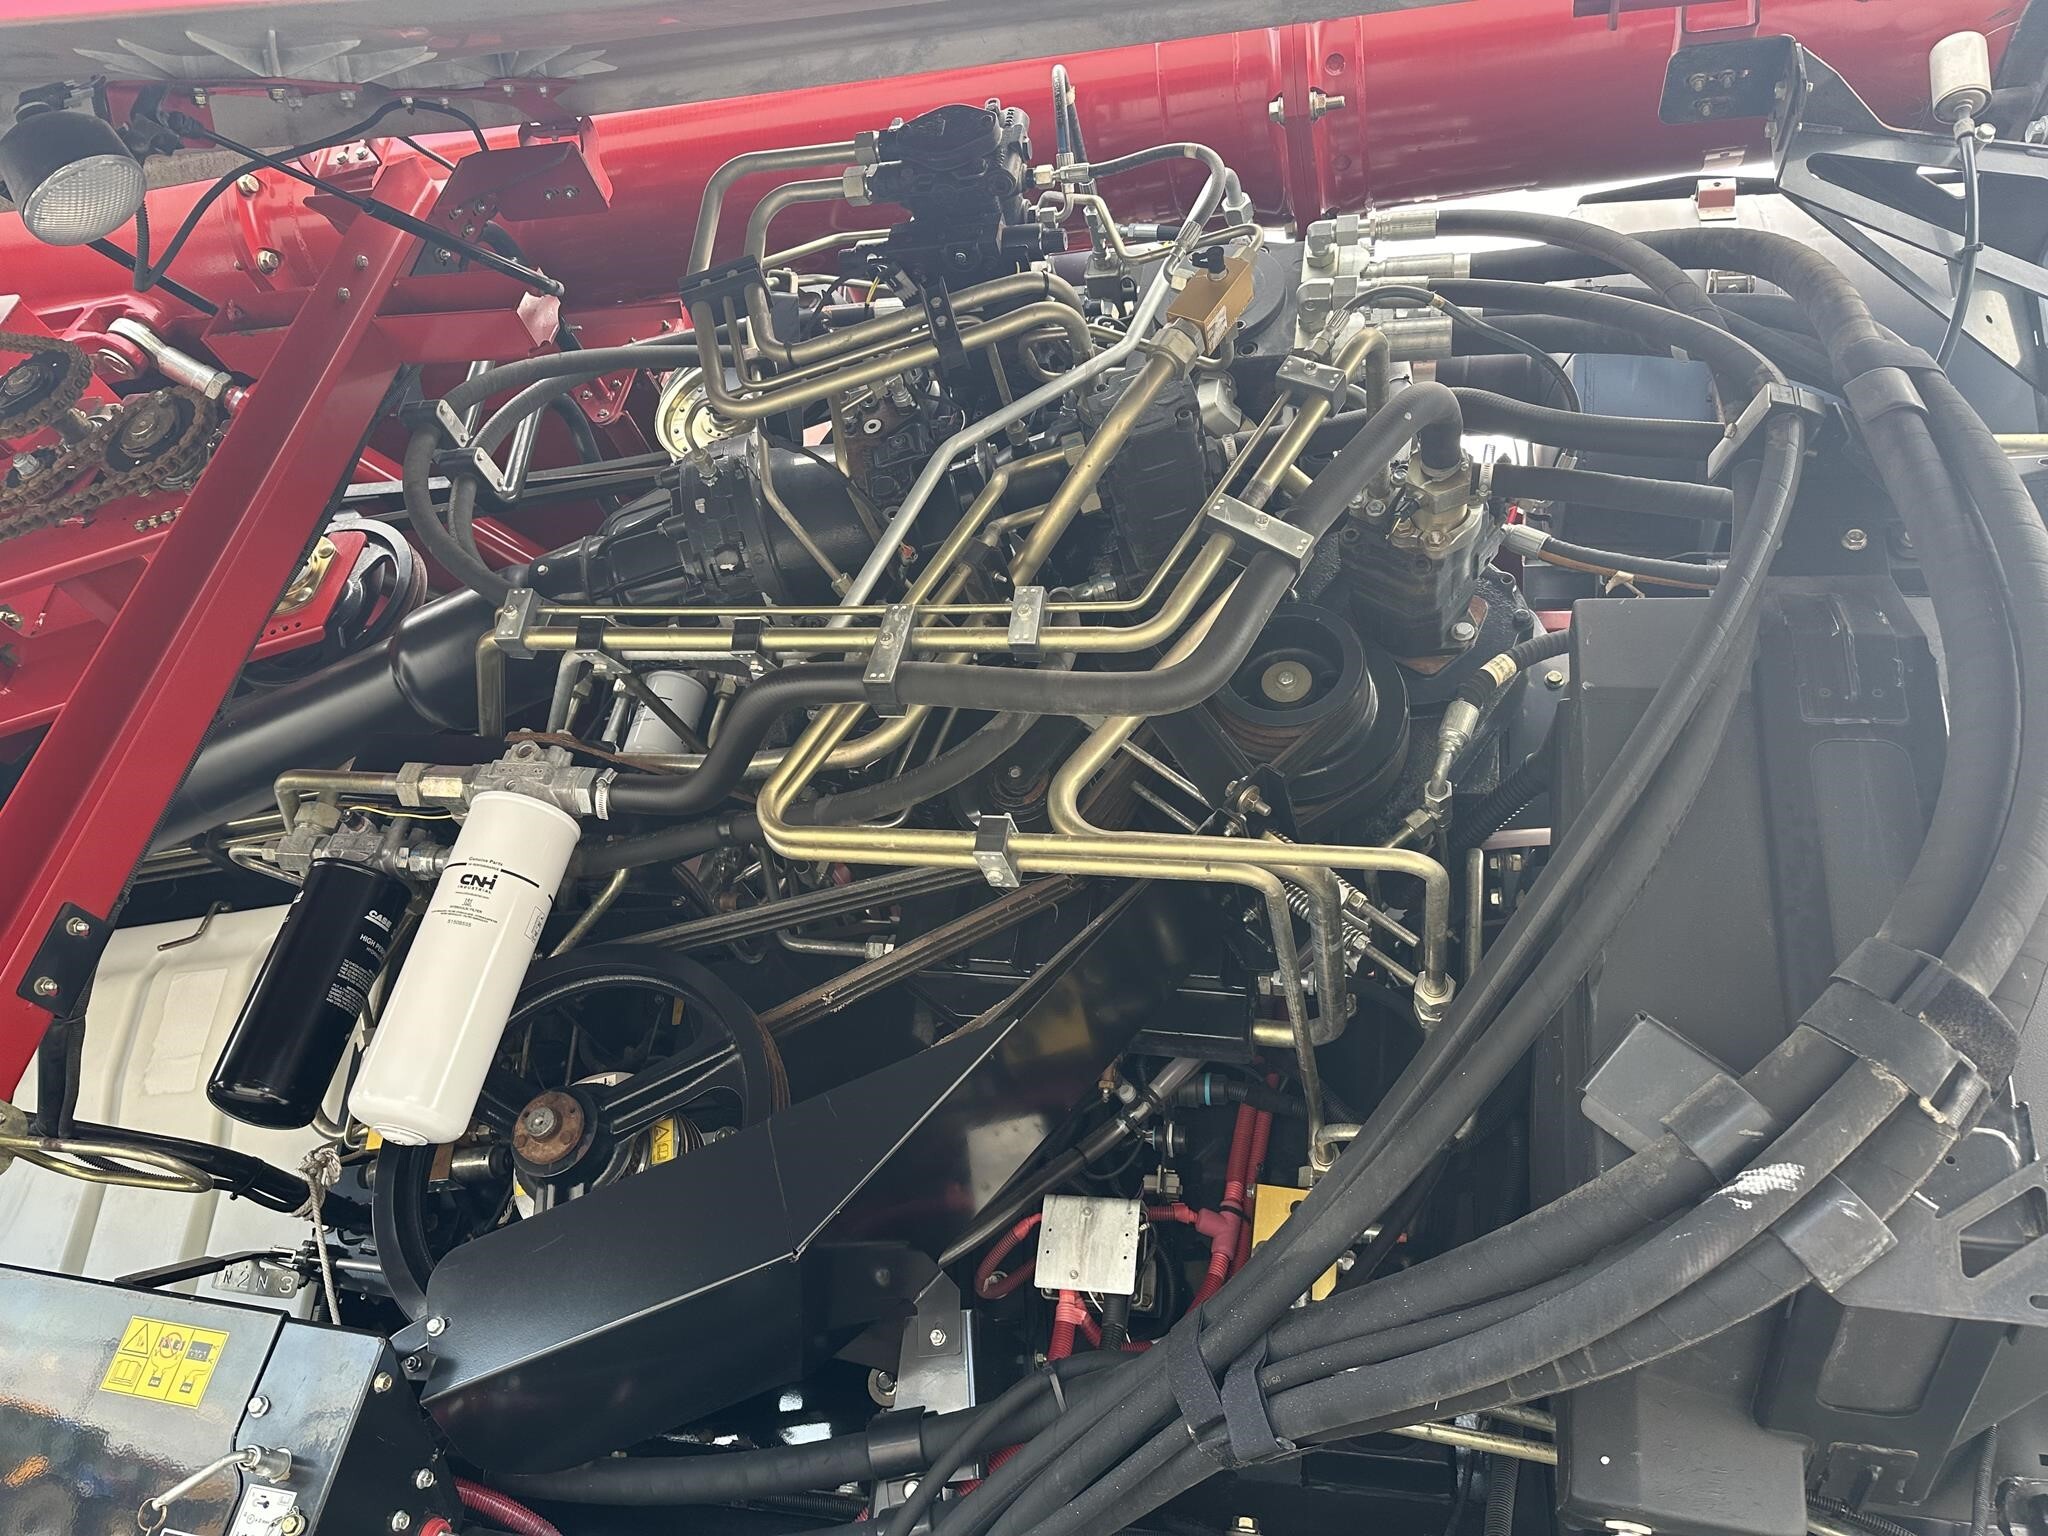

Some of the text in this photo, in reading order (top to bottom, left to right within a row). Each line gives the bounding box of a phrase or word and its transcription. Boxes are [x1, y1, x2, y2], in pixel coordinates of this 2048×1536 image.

[457, 885, 492, 894] INDUSTRIAL
[368, 910, 392, 929] CASE
[360, 933, 376, 947] HIGH
[237, 1271, 249, 1288] 2
[256, 1275, 268, 1291] N
[279, 1276, 294, 1293] 3
